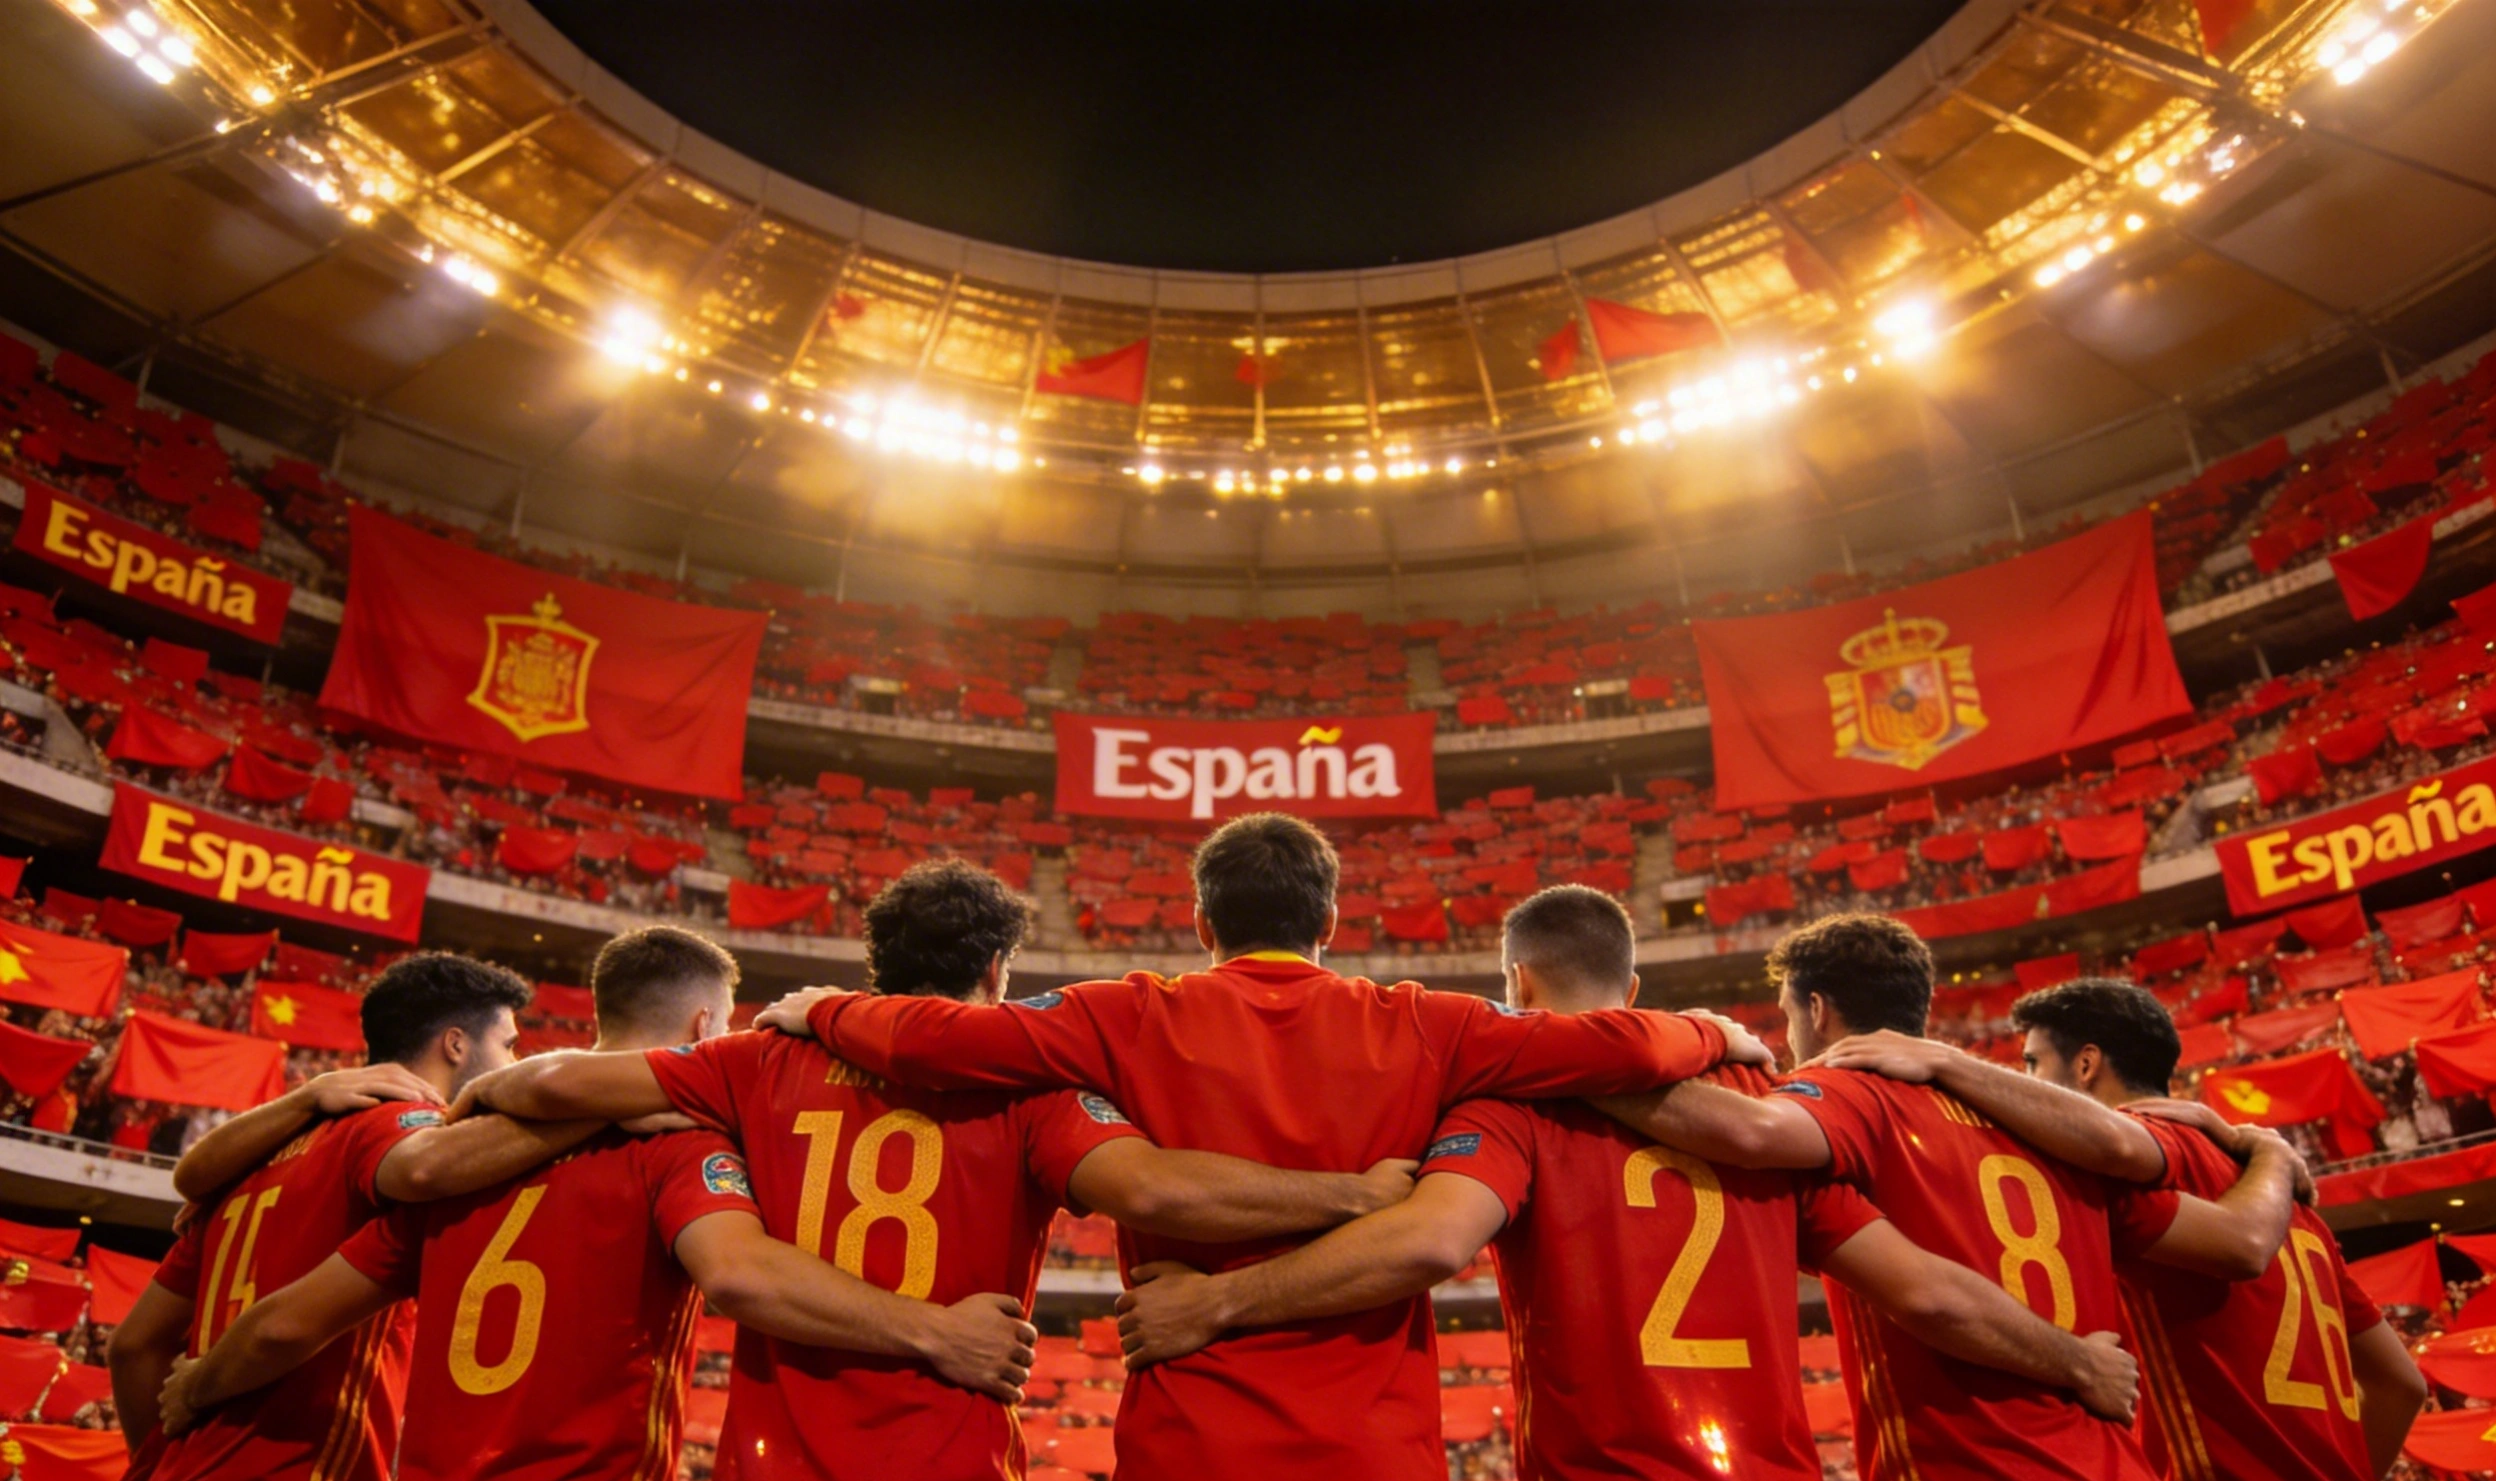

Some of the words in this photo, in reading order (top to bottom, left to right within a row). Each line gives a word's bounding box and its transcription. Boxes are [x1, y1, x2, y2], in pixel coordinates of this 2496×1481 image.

[43, 500, 257, 625] España
[137, 801, 392, 921] España
[1092, 725, 1403, 820] España
[2246, 778, 2496, 898] España
[448, 1184, 547, 1396] 6
[792, 1108, 944, 1300] 18
[1623, 1146, 1752, 1369] 2
[1978, 1154, 2077, 1331] 8
[2262, 1227, 2361, 1422] 26
